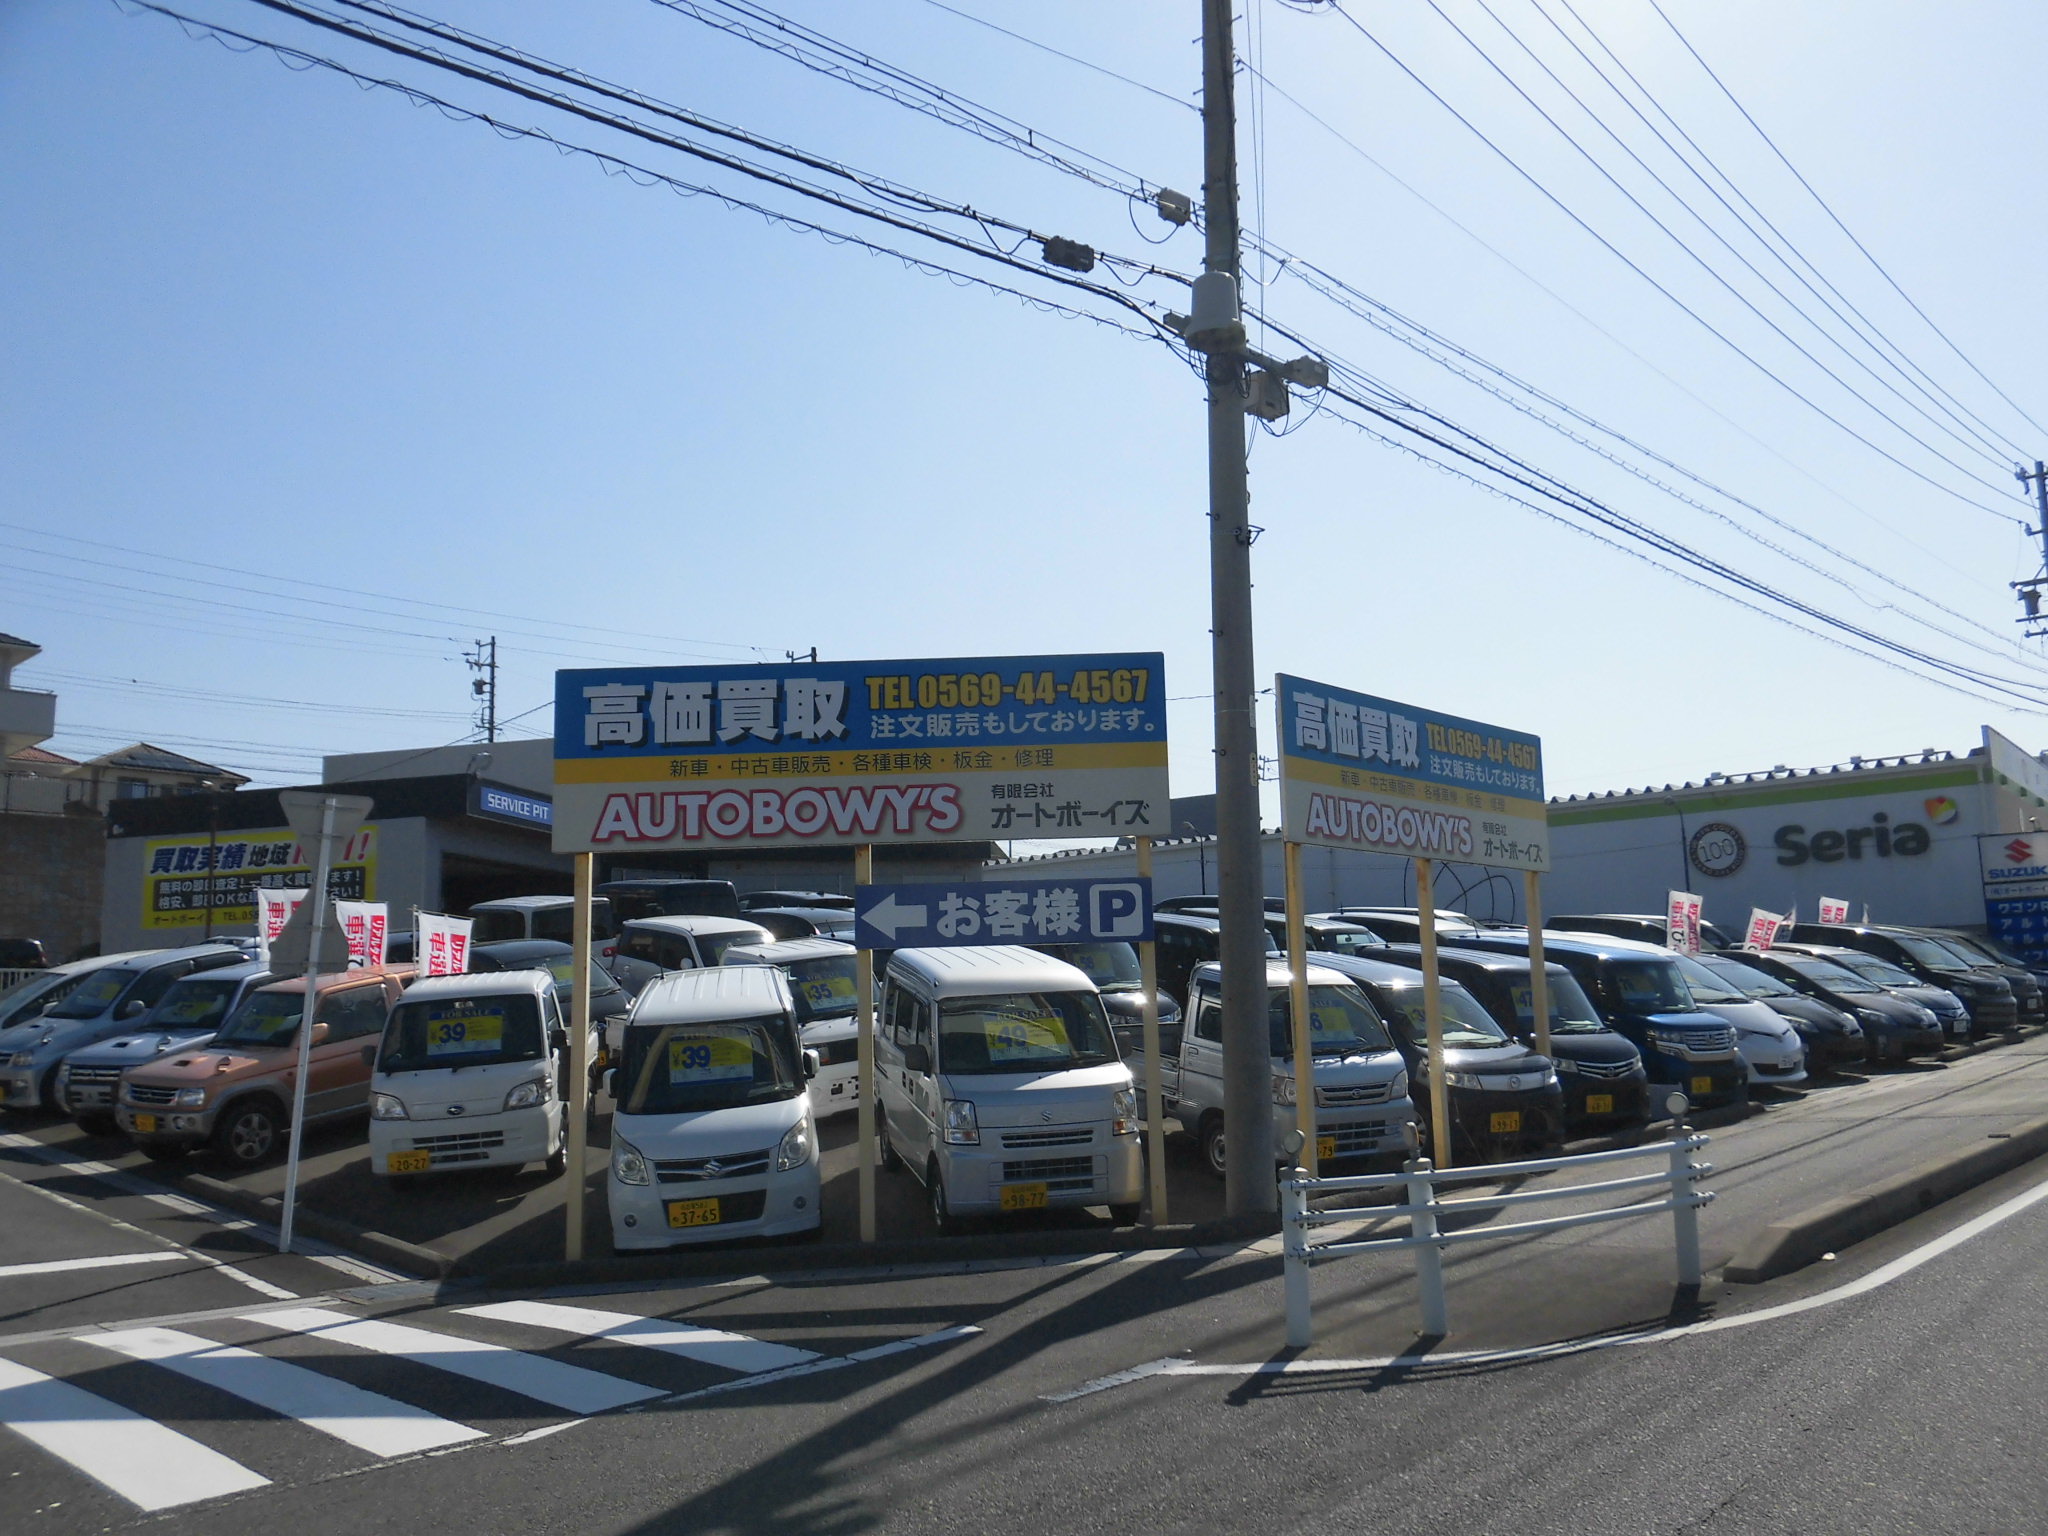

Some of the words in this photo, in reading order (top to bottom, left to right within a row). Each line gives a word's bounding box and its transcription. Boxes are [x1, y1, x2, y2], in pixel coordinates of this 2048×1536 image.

[582, 677, 847, 747] 高価買取
[870, 708, 1156, 739] 注文販売もしております。
[1293, 691, 1420, 769] 高価買取
[487, 792, 531, 816] SERVICE
[532, 804, 550, 820] PIT
[991, 782, 1054, 798] 有限会社
[592, 784, 963, 842] AUTOBOWY'S
[991, 800, 1150, 829] オートボーイズ
[1306, 793, 1473, 855] AUTOBOWY'S
[1483, 837, 1543, 863] オートボーイズ
[1699, 838, 1735, 863] 100
[1774, 811, 1931, 867] Seria
[937, 890, 1081, 938] お客様
